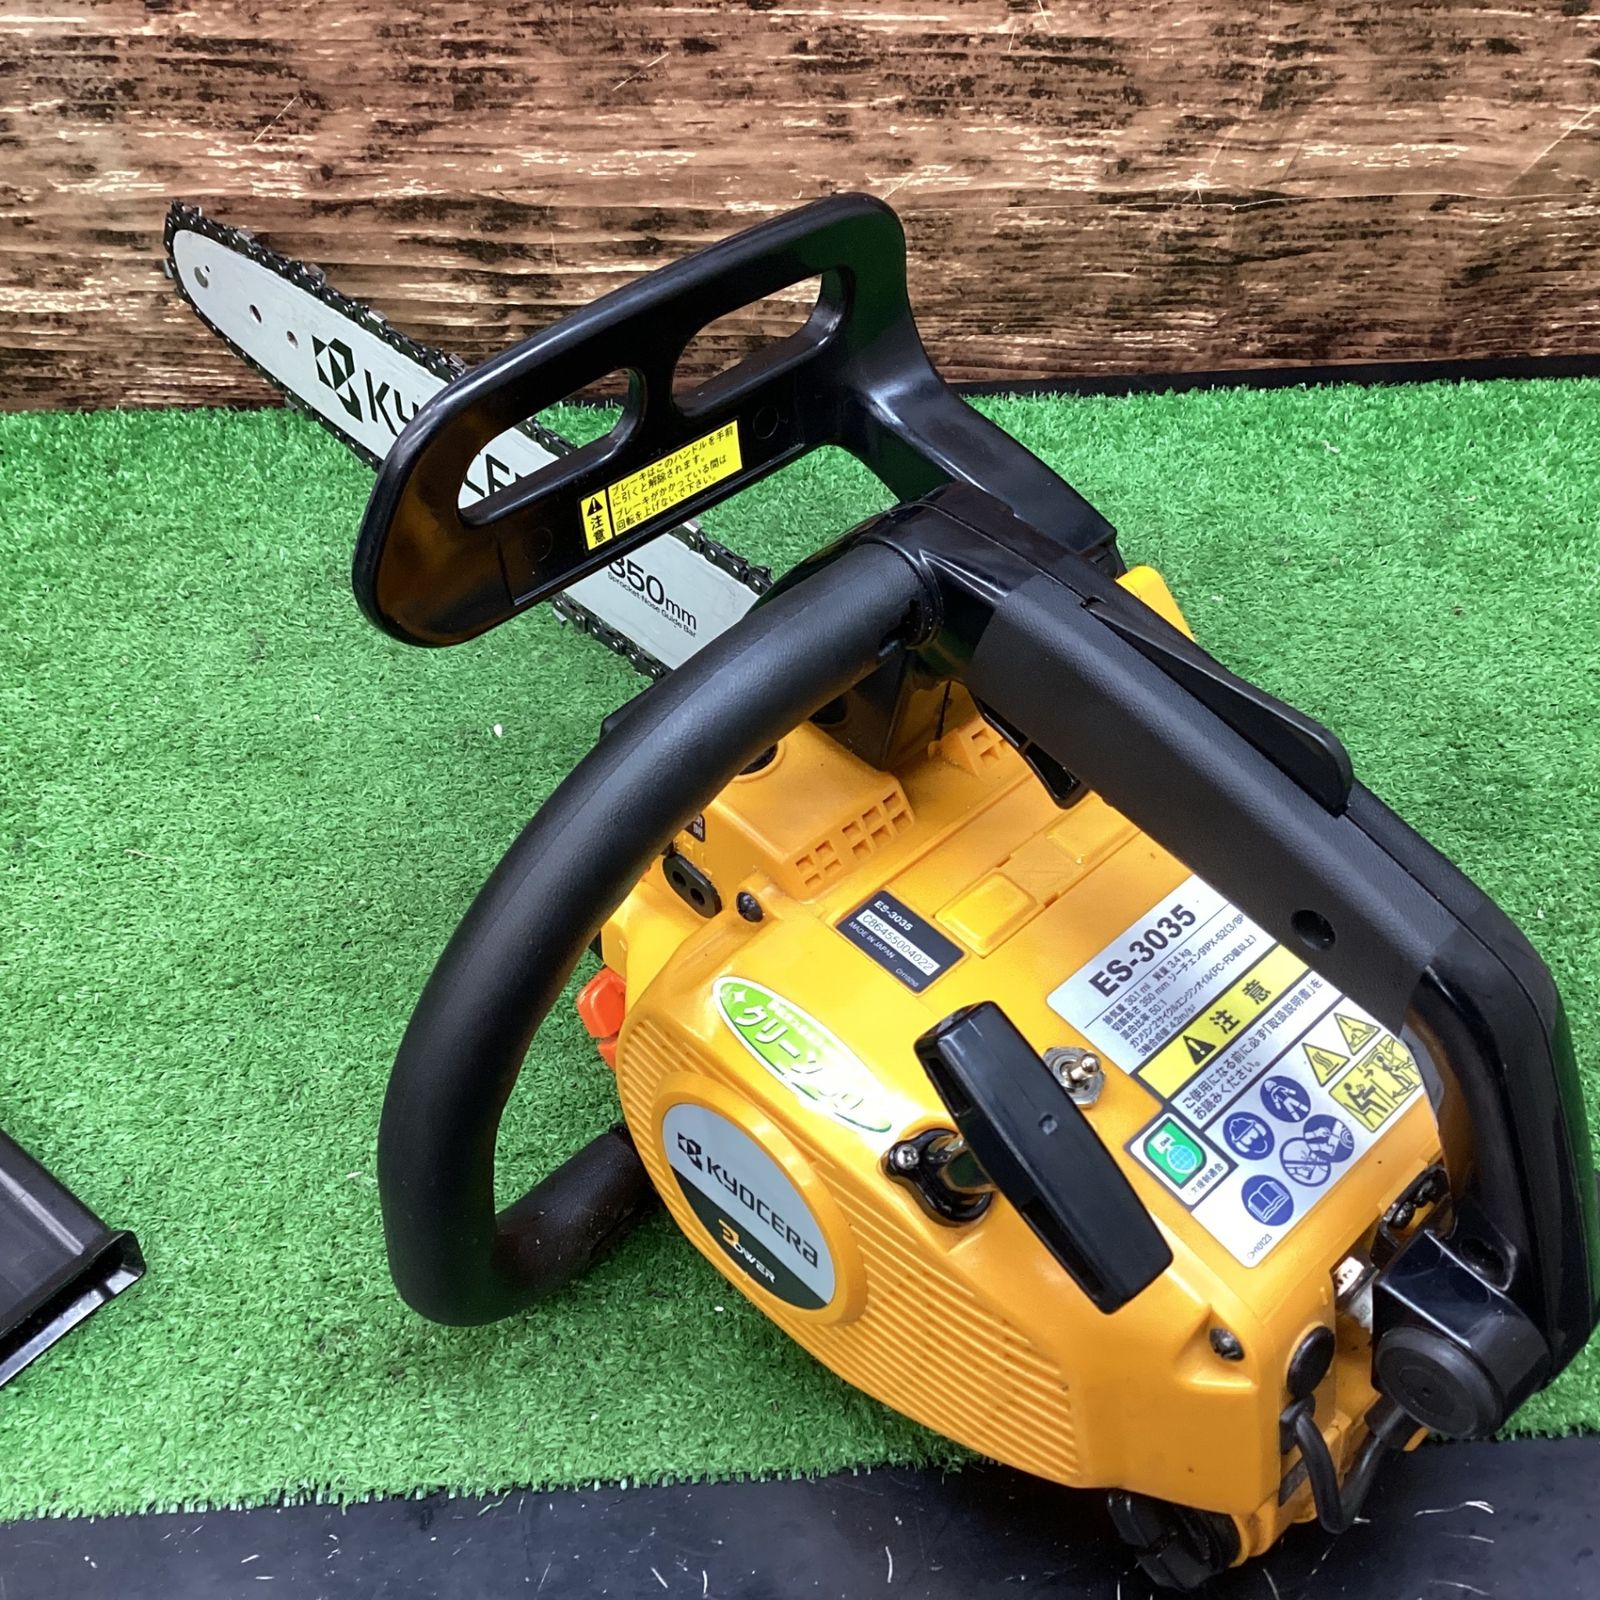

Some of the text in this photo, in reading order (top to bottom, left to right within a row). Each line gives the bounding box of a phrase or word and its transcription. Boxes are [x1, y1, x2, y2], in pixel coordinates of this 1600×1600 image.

[612, 425, 734, 497] ブレーキはこのハンドルを手前
[612, 454, 706, 508] に引くと解除されます。
[615, 454, 727, 520] ブレーキがかかっている間は
[590, 515, 606, 545] 注意
[616, 475, 717, 532] 回転を上げないで下さい。
[661, 609, 683, 629] Guide
[683, 625, 697, 638] Bar
[848, 921, 896, 959] MADE IN JAPAN
[874, 900, 913, 931] ES-3035
[1088, 904, 1197, 998] ES-3035
[1124, 991, 1141, 1006] 30.1
[1167, 957, 1181, 969] 3.4
[1179, 948, 1193, 960] kg
[1111, 1005, 1142, 1032] 切断長さ
[1139, 992, 1156, 1007] 350
[1154, 980, 1171, 995] mm
[1120, 1011, 1151, 1041] 混合比率
[1182, 978, 1323, 1110] ご使用になる前に必ず「取扱説明書」を
[1193, 1061, 1261, 1120] お読みください。
[707, 1156, 819, 1269] KYOCERA
